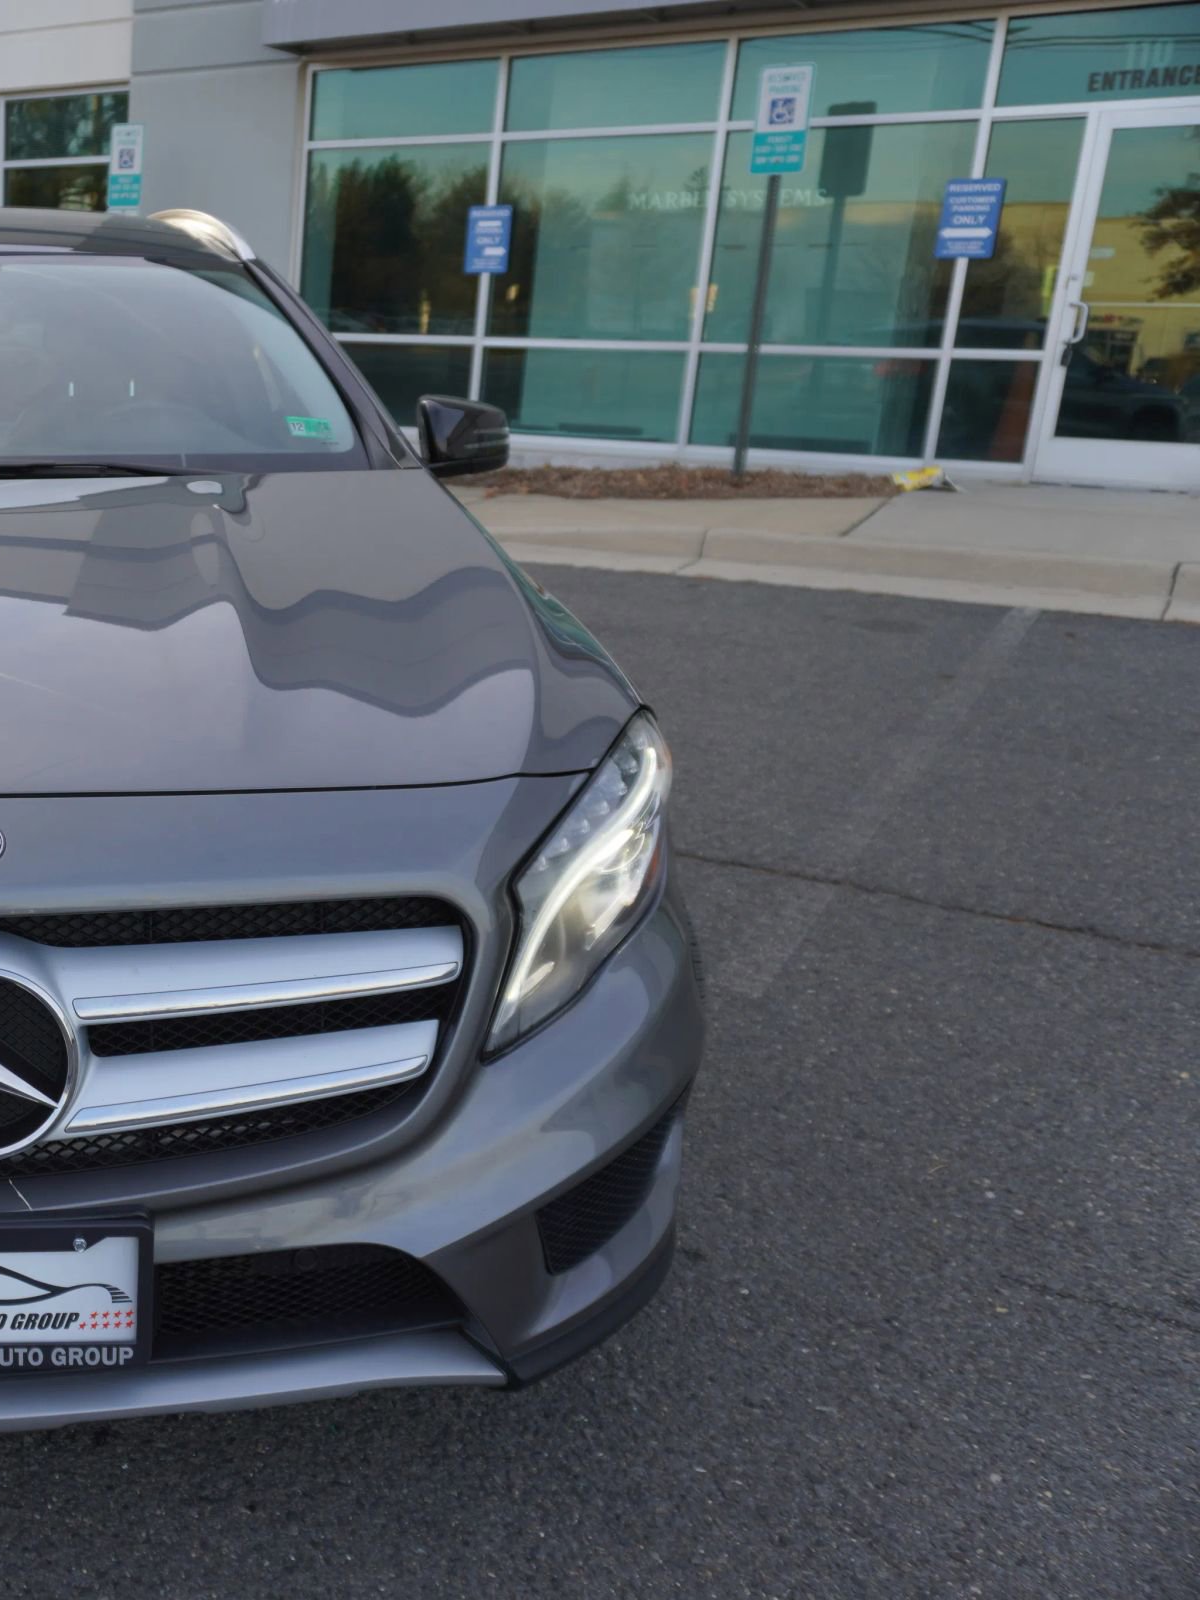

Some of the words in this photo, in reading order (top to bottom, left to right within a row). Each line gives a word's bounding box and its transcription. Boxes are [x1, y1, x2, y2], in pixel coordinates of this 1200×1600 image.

[949, 183, 1001, 193] RESERVED
[628, 190, 706, 210] MARBL
[725, 187, 827, 208] SYSEMS
[953, 214, 987, 225] ONLY
[9, 1311, 80, 1331] GROUP
[50, 1346, 134, 1367] GROUP
